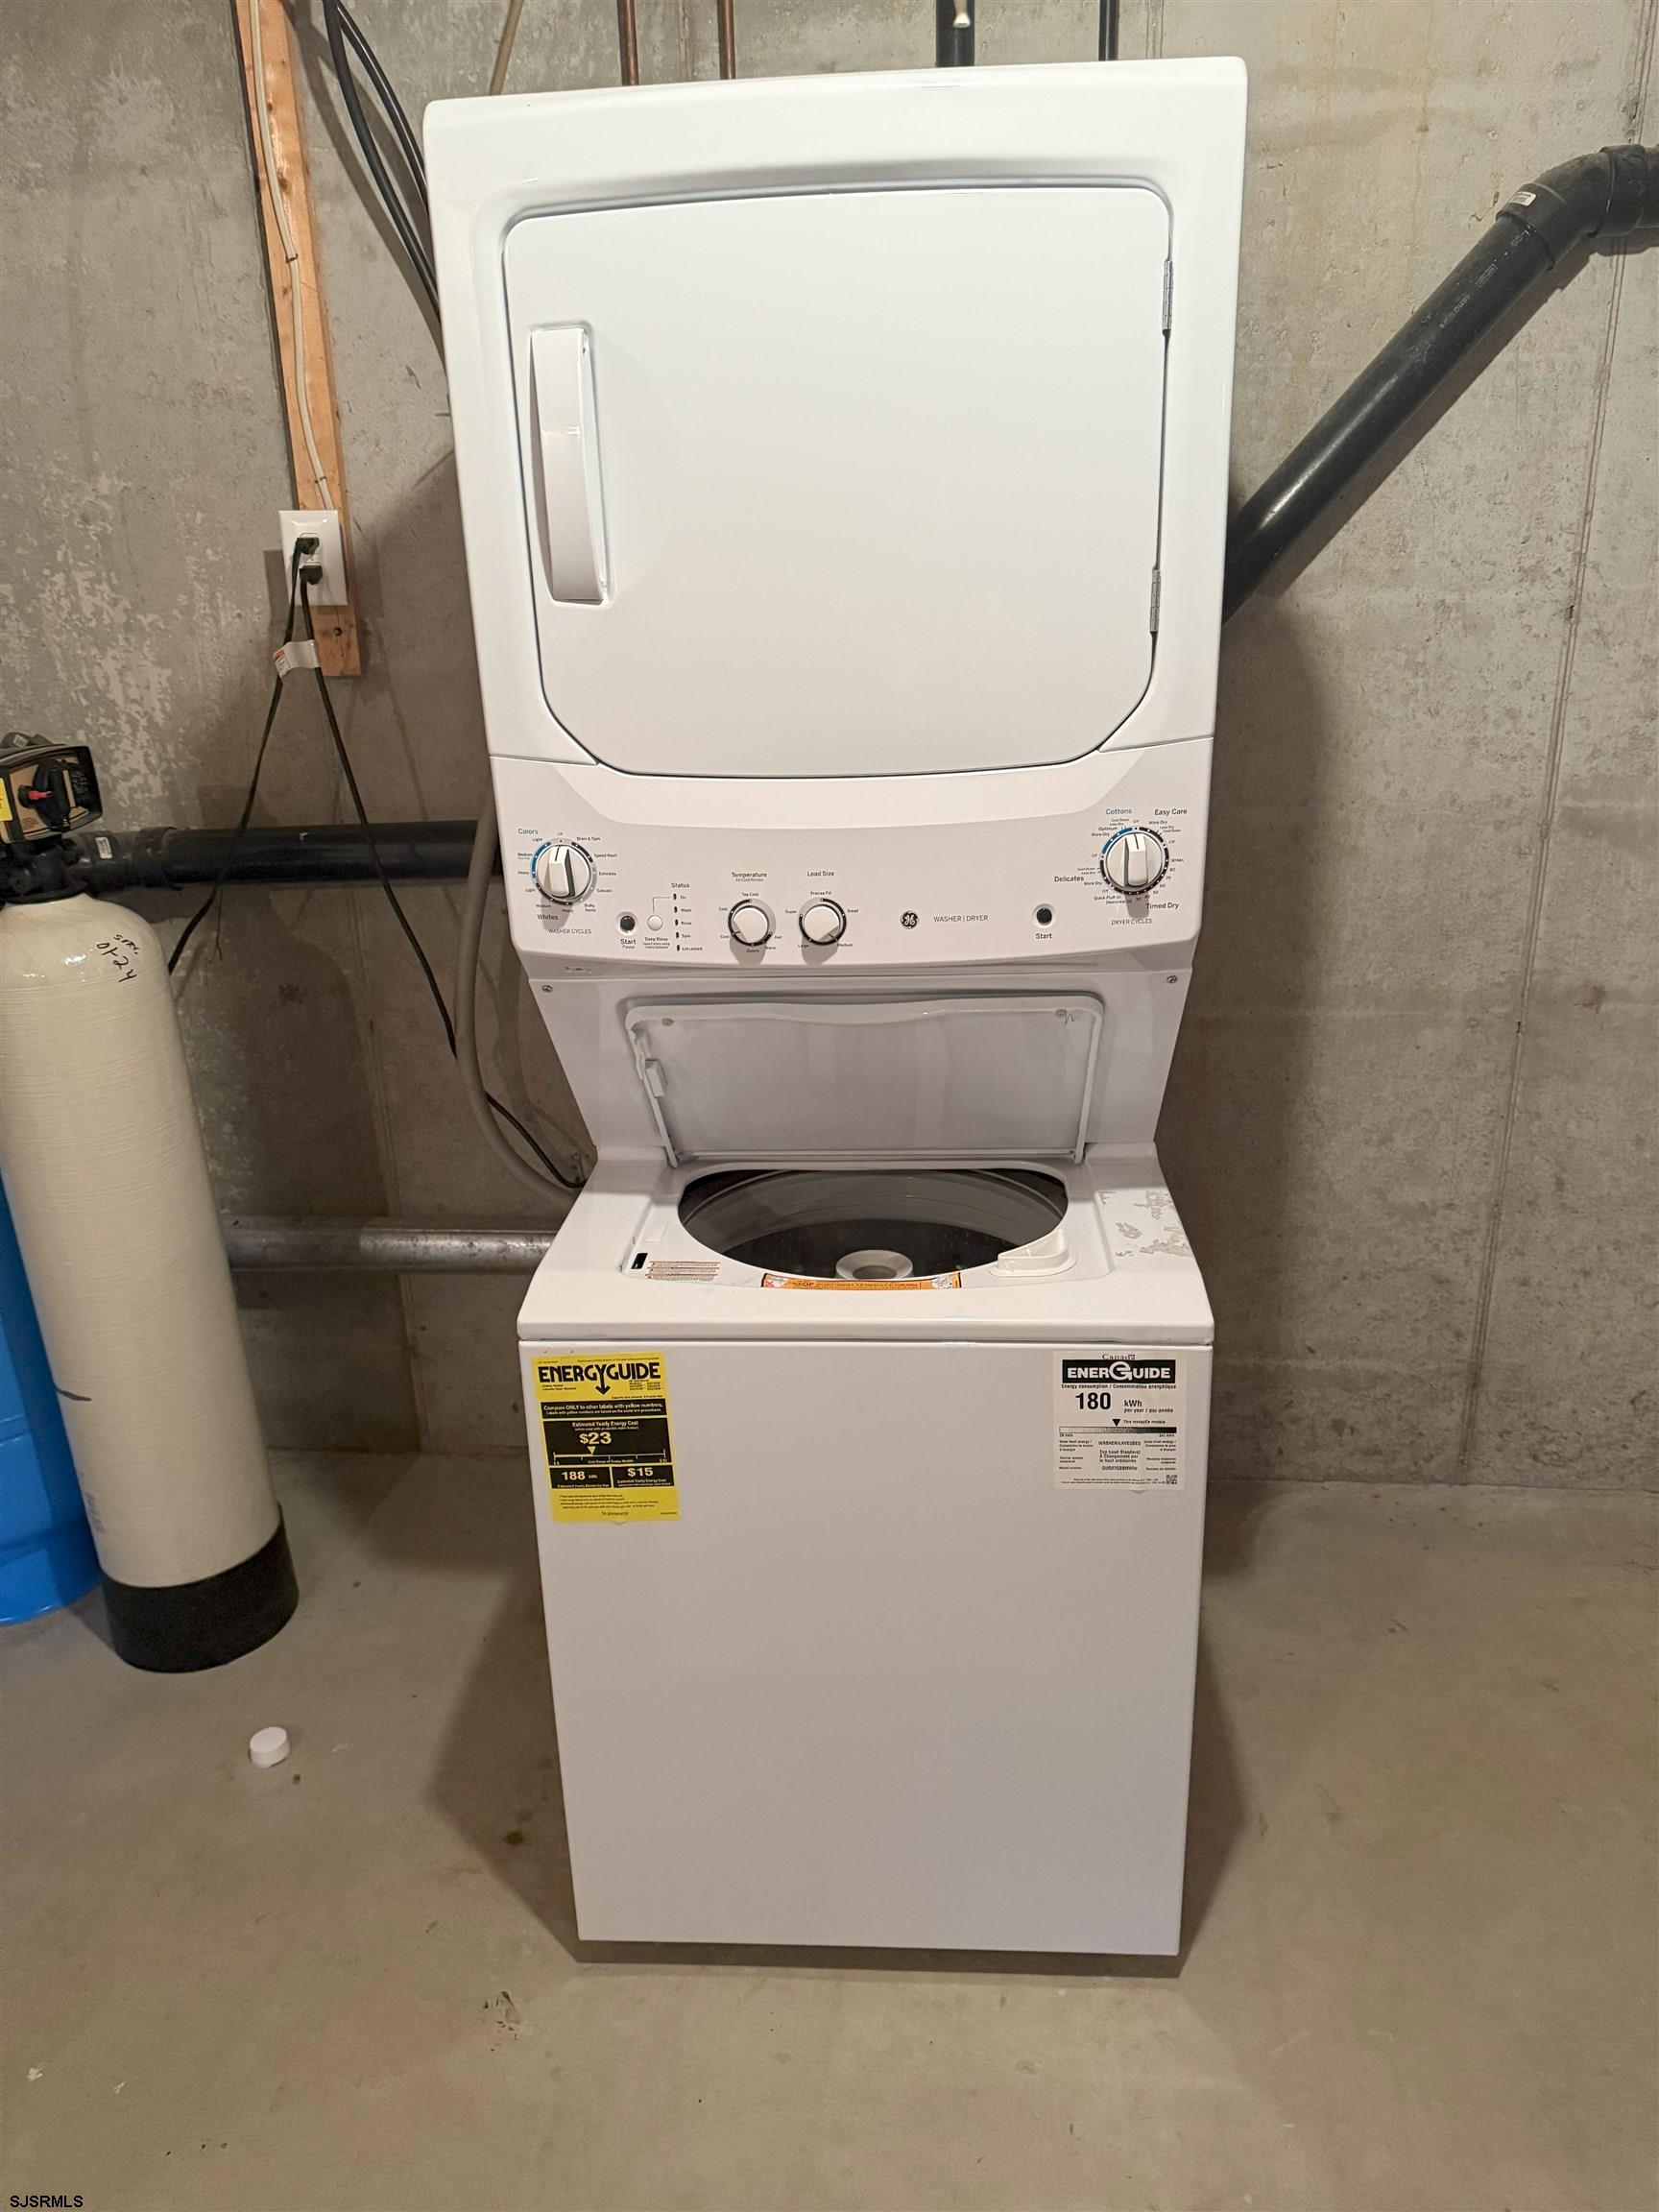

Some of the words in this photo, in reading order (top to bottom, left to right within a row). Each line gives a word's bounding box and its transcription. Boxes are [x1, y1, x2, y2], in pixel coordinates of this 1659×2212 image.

[538, 1362, 661, 1382] ENERGYGUIDE
[1076, 1392, 1111, 1410] 180
[579, 1432, 611, 1444] $23
[561, 1471, 585, 1481] 188
[627, 1467, 653, 1477] $15
